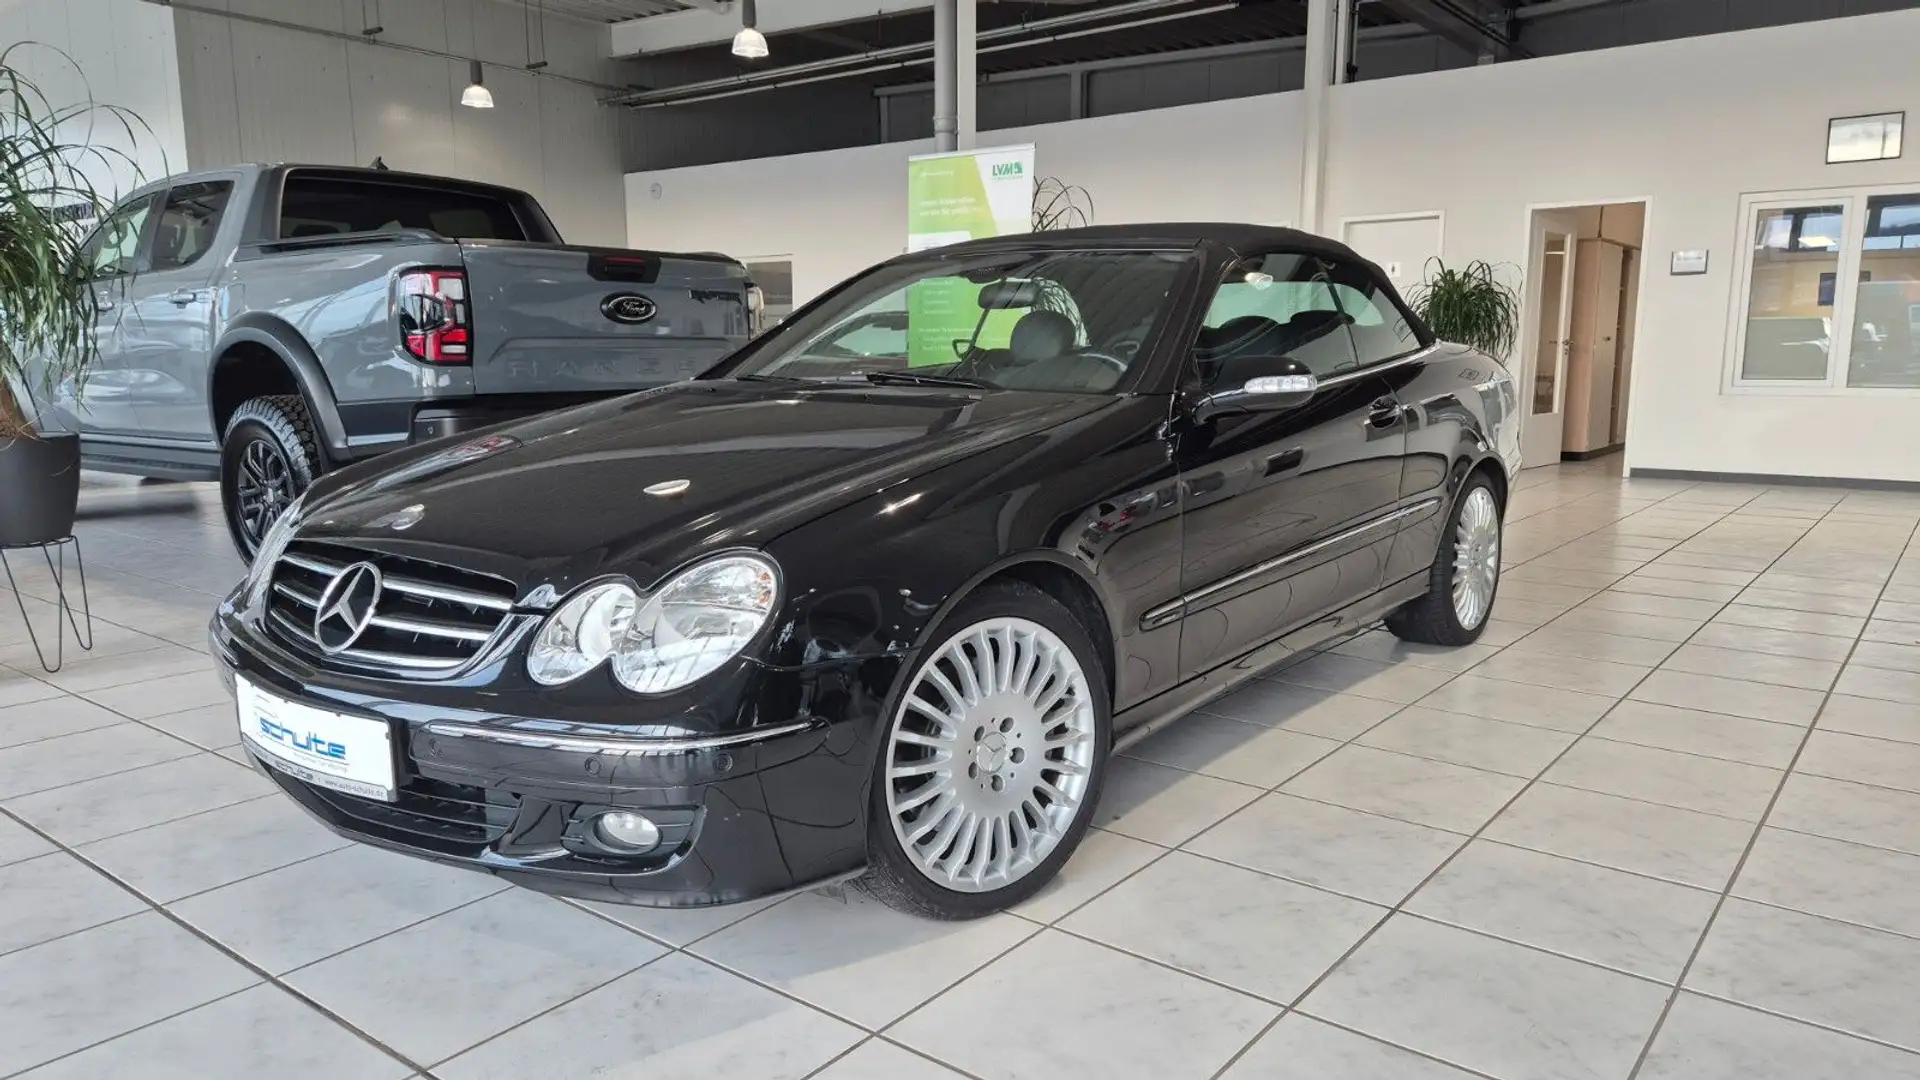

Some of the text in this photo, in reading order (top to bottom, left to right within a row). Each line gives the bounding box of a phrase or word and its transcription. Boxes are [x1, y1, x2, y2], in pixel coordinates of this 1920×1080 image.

[992, 162, 1013, 176] LVM
[619, 299, 646, 314] Ford
[506, 354, 716, 378] RANGE
